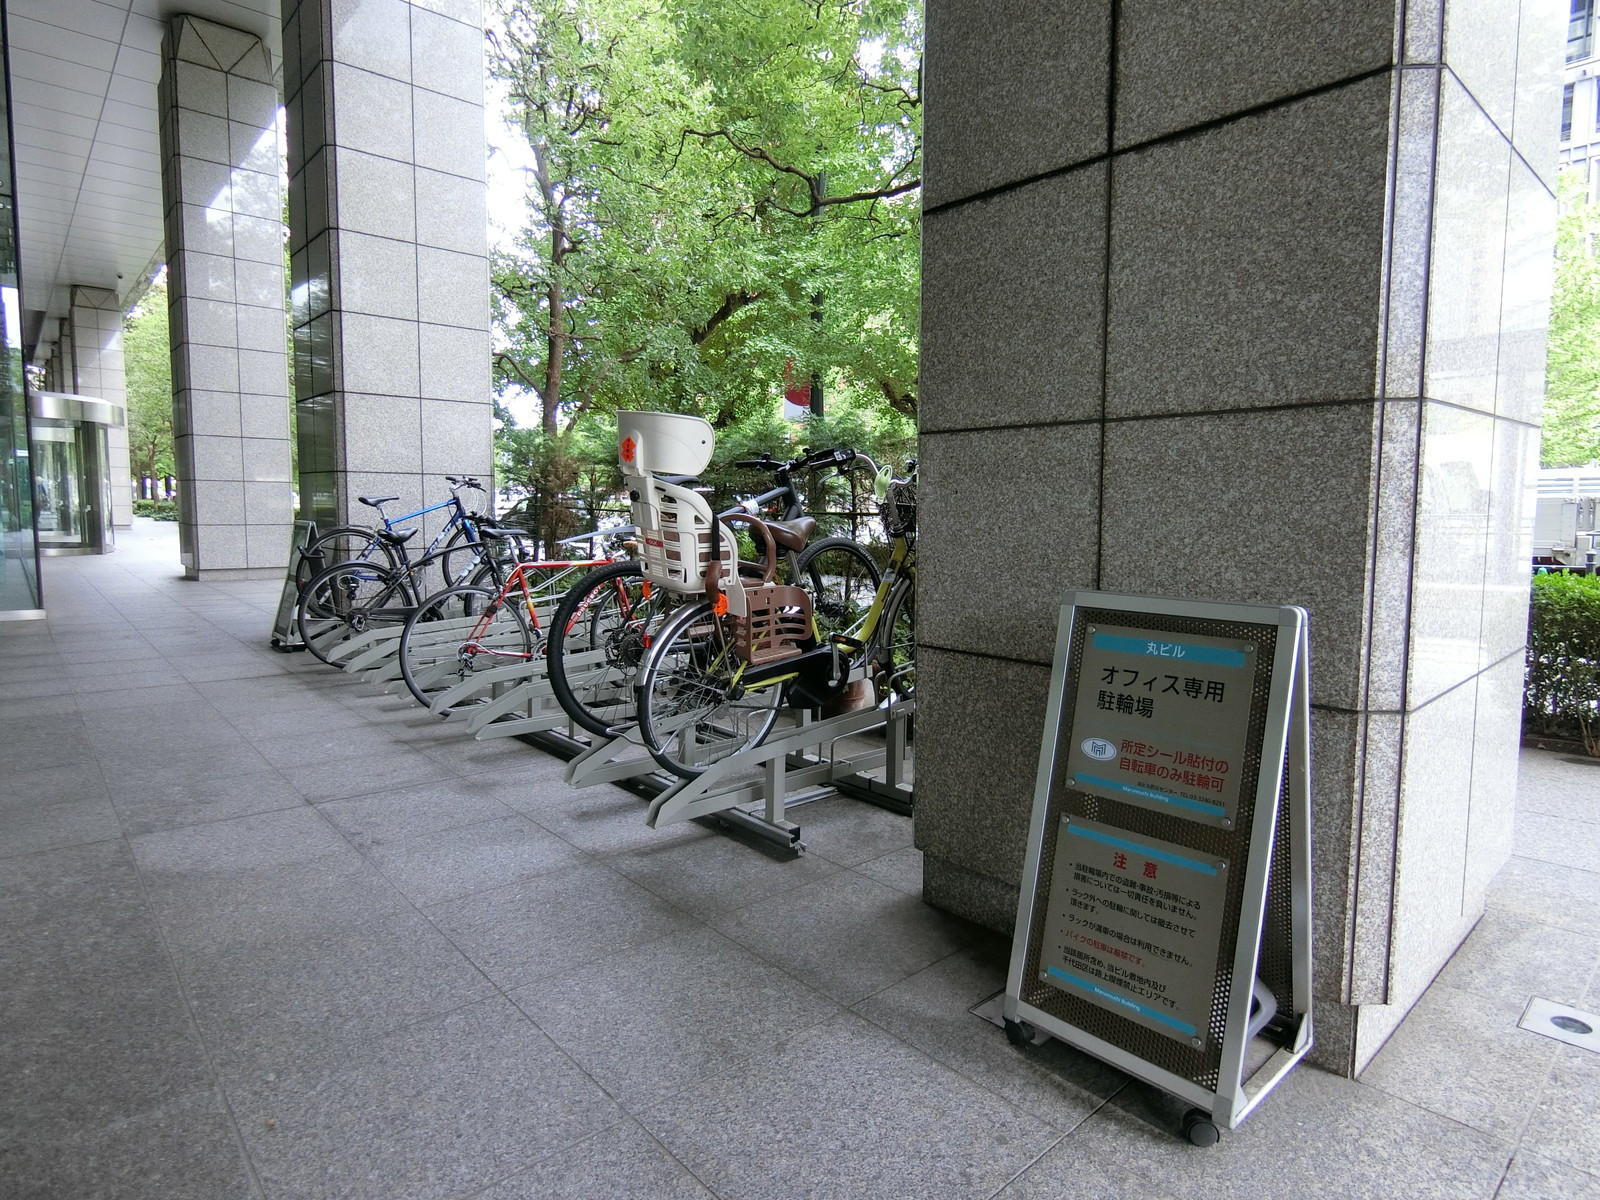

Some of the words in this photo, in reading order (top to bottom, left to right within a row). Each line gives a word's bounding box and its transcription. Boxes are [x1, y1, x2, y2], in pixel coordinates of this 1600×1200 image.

[576, 585, 601, 616] PEUGEOT
[1146, 641, 1186, 658] 丸ビル
[1100, 666, 1225, 703] オフィス専用
[1096, 690, 1155, 718] 駐輪場
[1120, 739, 1229, 774] 所定シール貼付の
[1119, 757, 1226, 792] 自転車のみ駐輪可
[1149, 791, 1169, 803] Building
[1070, 897, 1100, 915] 頂きます。
[1071, 887, 1196, 938] ラック外への駐輪に関しては撤去させて
[1073, 872, 1198, 921] 損害については一切責任を負いません。
[1065, 929, 1146, 968] バイクの駐車は厳禁です。
[1068, 913, 1194, 967] ラックが満車の場合は利用できません。
[1062, 955, 1180, 1010] 千代田区は路上喫煙禁止エリアです。
